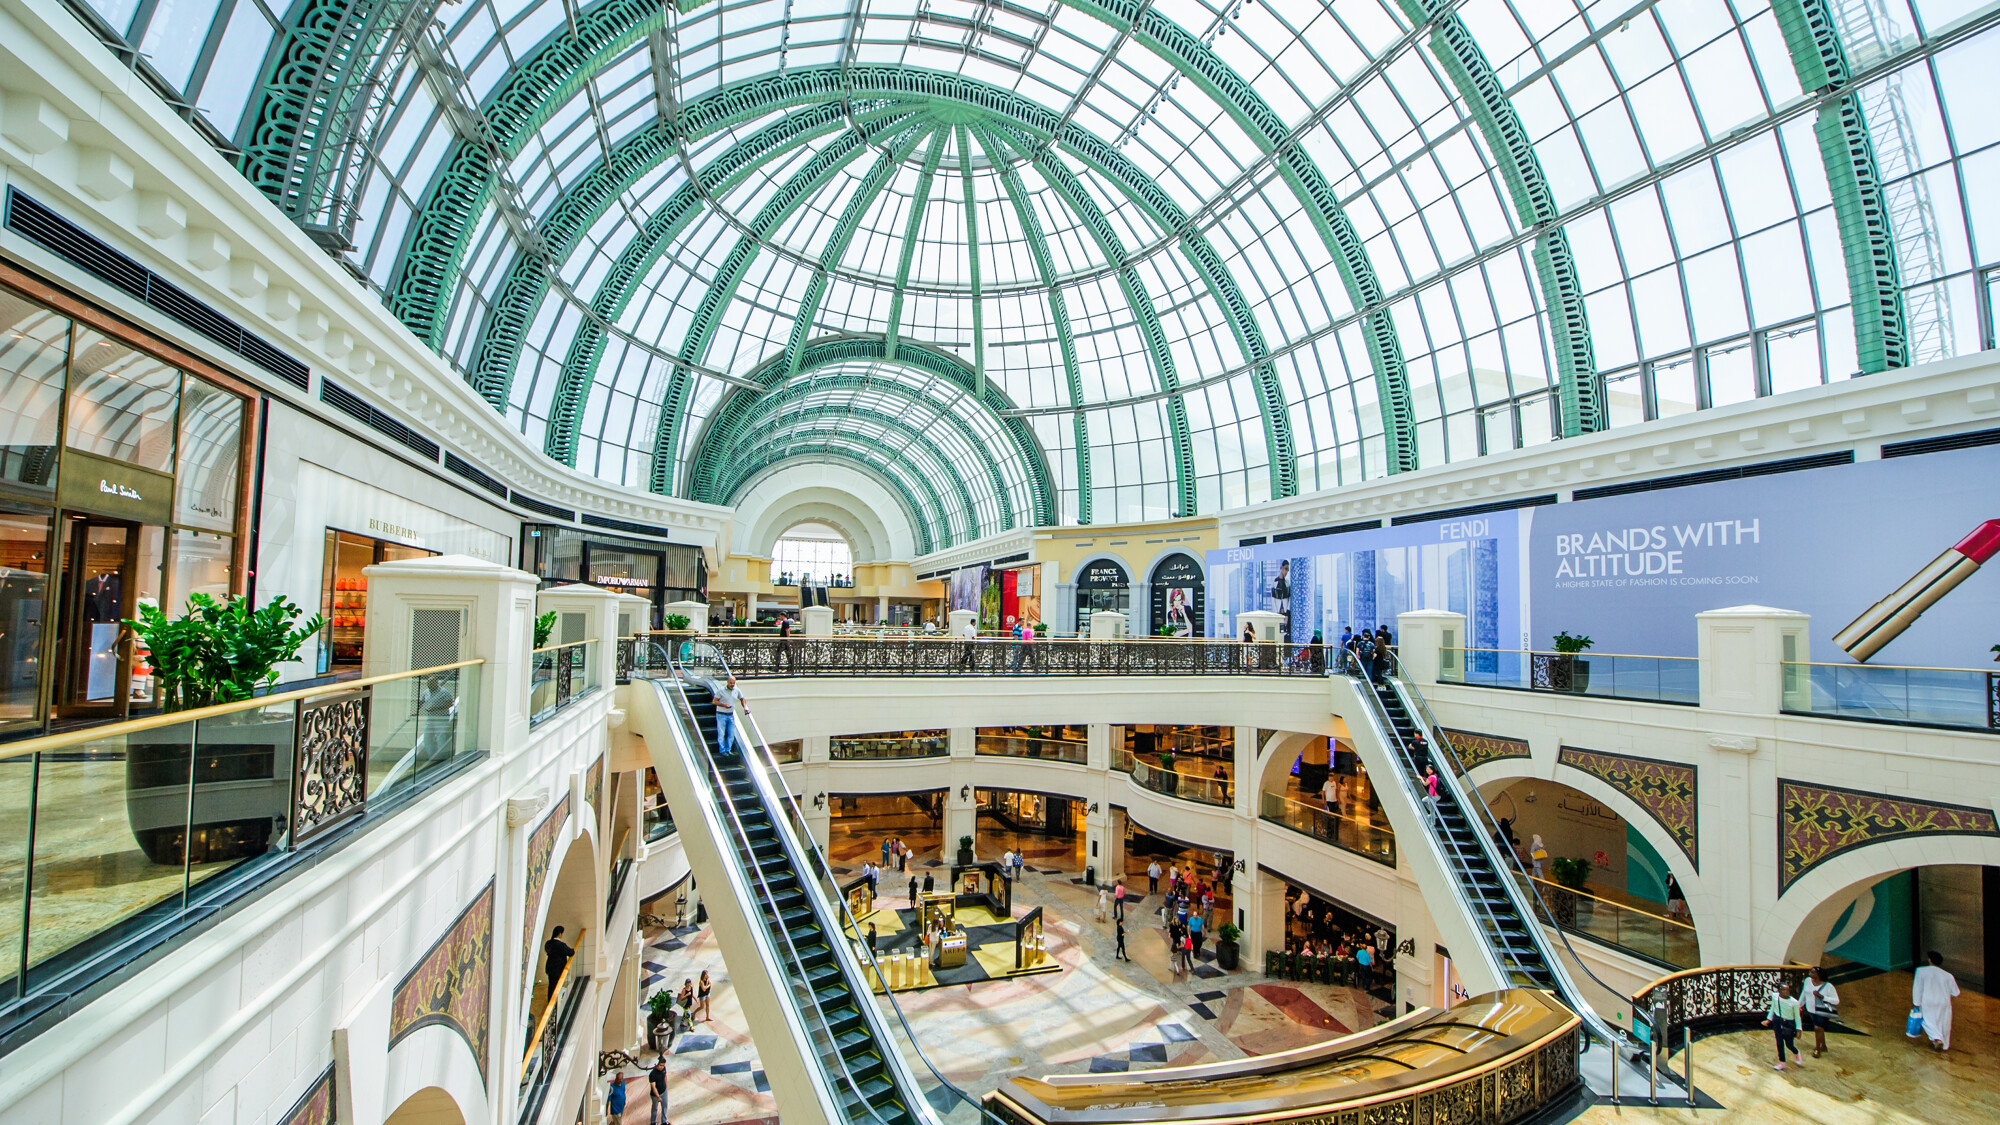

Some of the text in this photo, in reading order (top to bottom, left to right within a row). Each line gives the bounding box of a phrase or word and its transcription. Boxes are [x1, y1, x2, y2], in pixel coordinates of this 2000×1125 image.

[100, 480, 142, 500] Paul Smith
[369, 518, 418, 540] BURBERRY
[1440, 518, 1489, 541] FENDI
[1556, 518, 1760, 556] BRANDS WITH
[1227, 548, 1255, 562] FENDI
[1555, 551, 1683, 579] ALTITUDE
[1090, 568, 1117, 576] FRANCK
[1562, 580, 1590, 588] HIGHER
[1591, 579, 1613, 588] STATE
[1615, 579, 1628, 587] OF
[1629, 577, 1668, 586] FASHION
[1670, 577, 1678, 586] IS
[1679, 576, 1723, 586] COMING
[1725, 575, 1760, 585] SOON.
